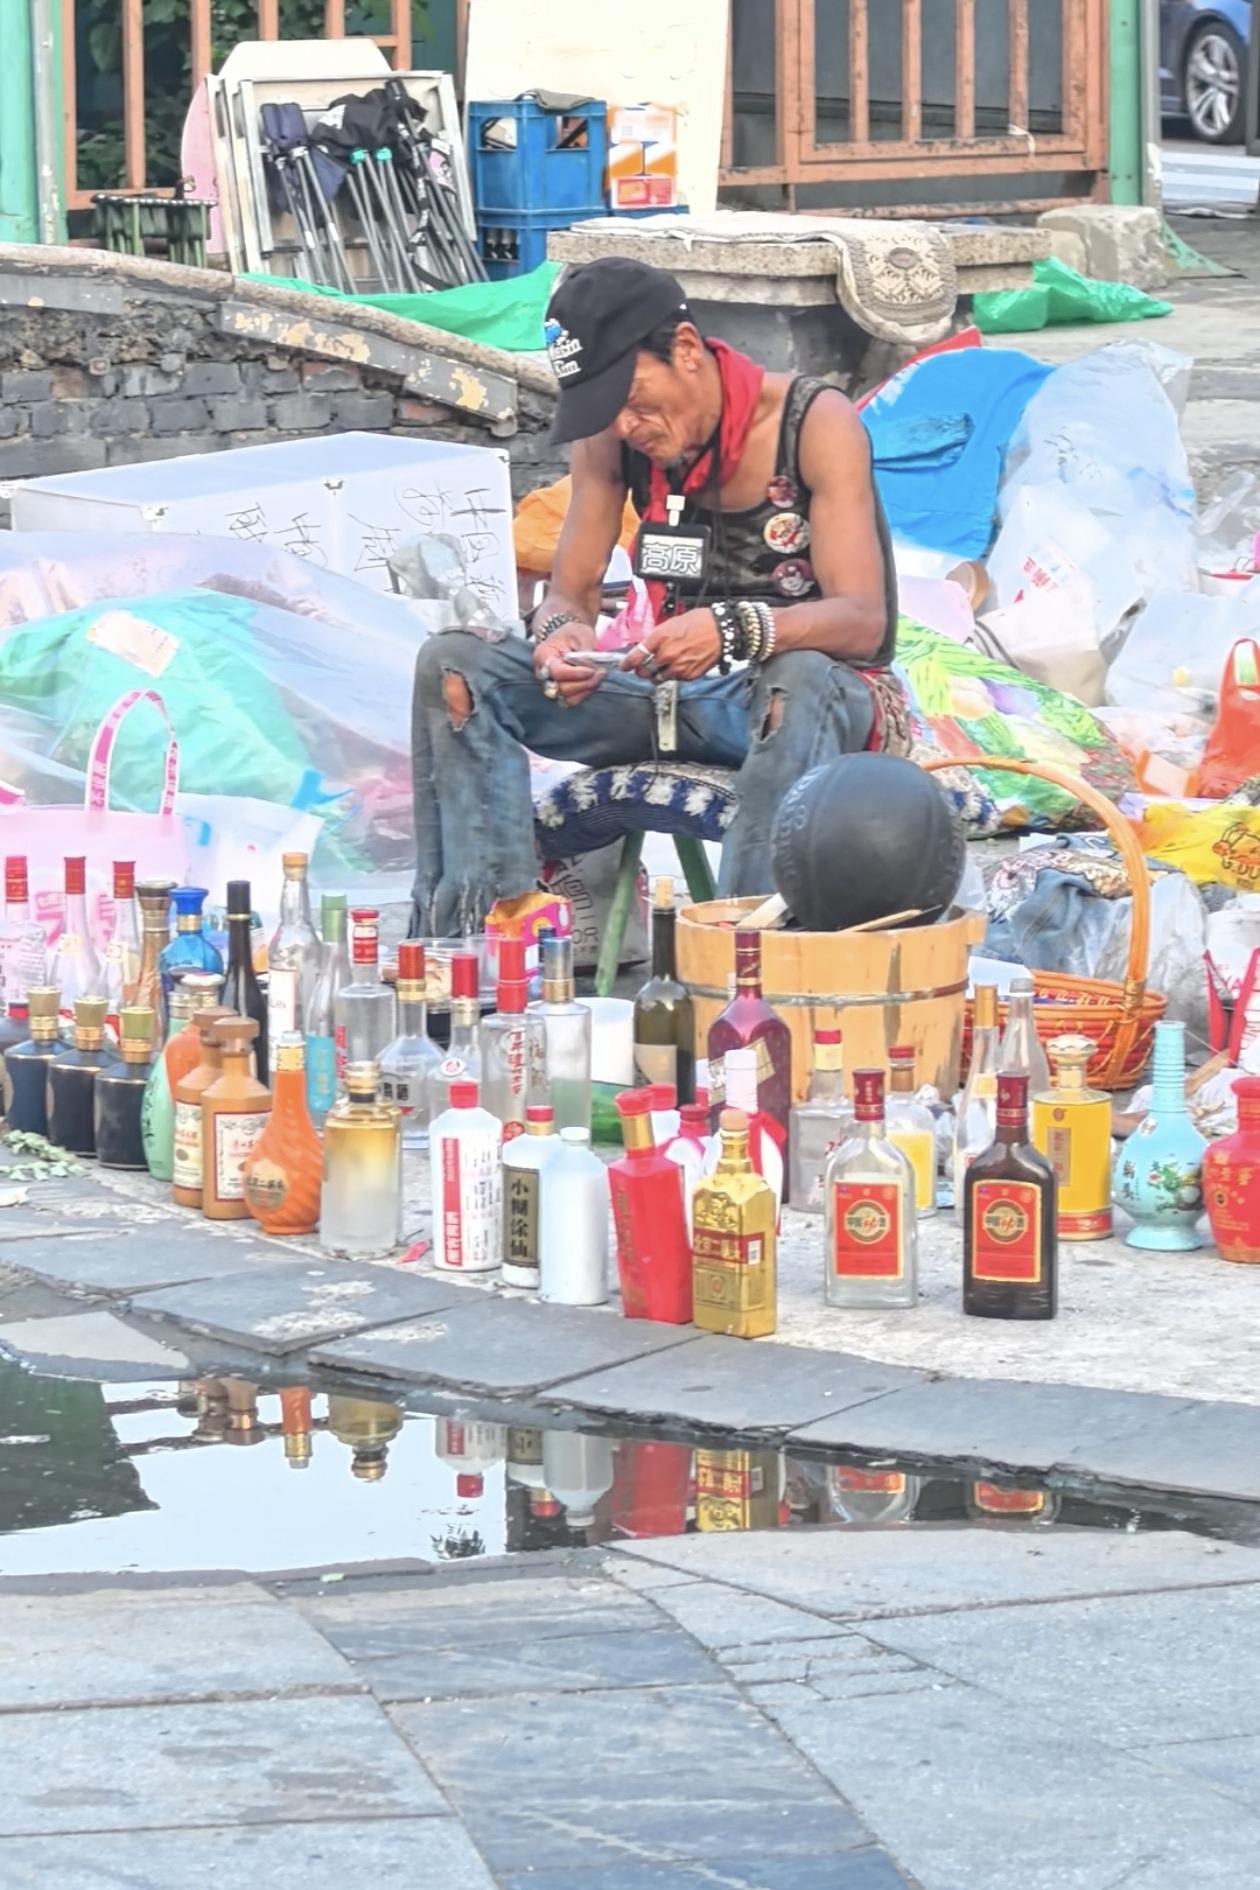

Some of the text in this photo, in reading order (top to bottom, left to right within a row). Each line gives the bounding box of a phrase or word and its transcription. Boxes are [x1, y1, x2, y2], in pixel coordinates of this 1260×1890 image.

[642, 541, 700, 574] 高原
[511, 1178, 529, 1258] 小糊涂仙
